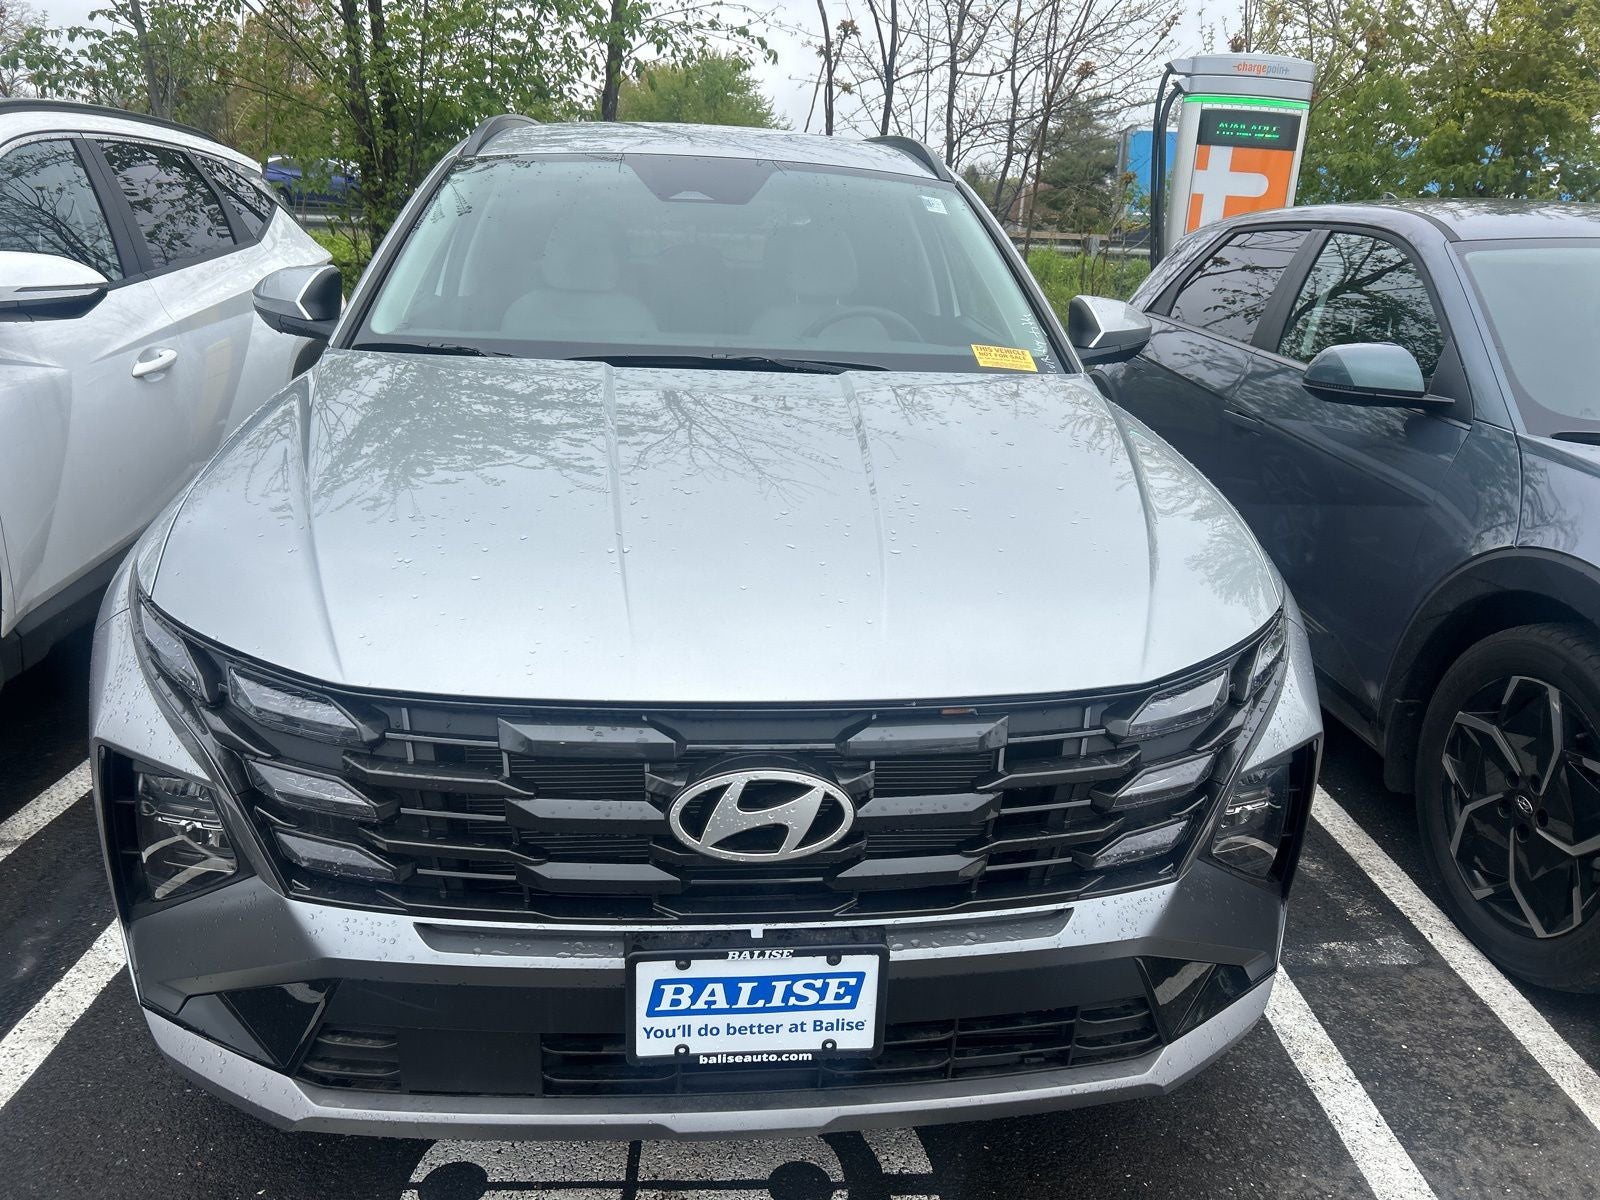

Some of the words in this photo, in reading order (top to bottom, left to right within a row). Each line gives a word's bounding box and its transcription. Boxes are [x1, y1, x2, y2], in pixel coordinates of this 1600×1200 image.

[994, 347, 1026, 356] VEHICLE
[727, 950, 794, 961] BALISE
[655, 977, 858, 1011] BALISE
[643, 1023, 691, 1039] You'll
[697, 1024, 720, 1037] do
[726, 1021, 783, 1036] better
[787, 1021, 807, 1034] at
[698, 1052, 812, 1065] baliseauto.com
